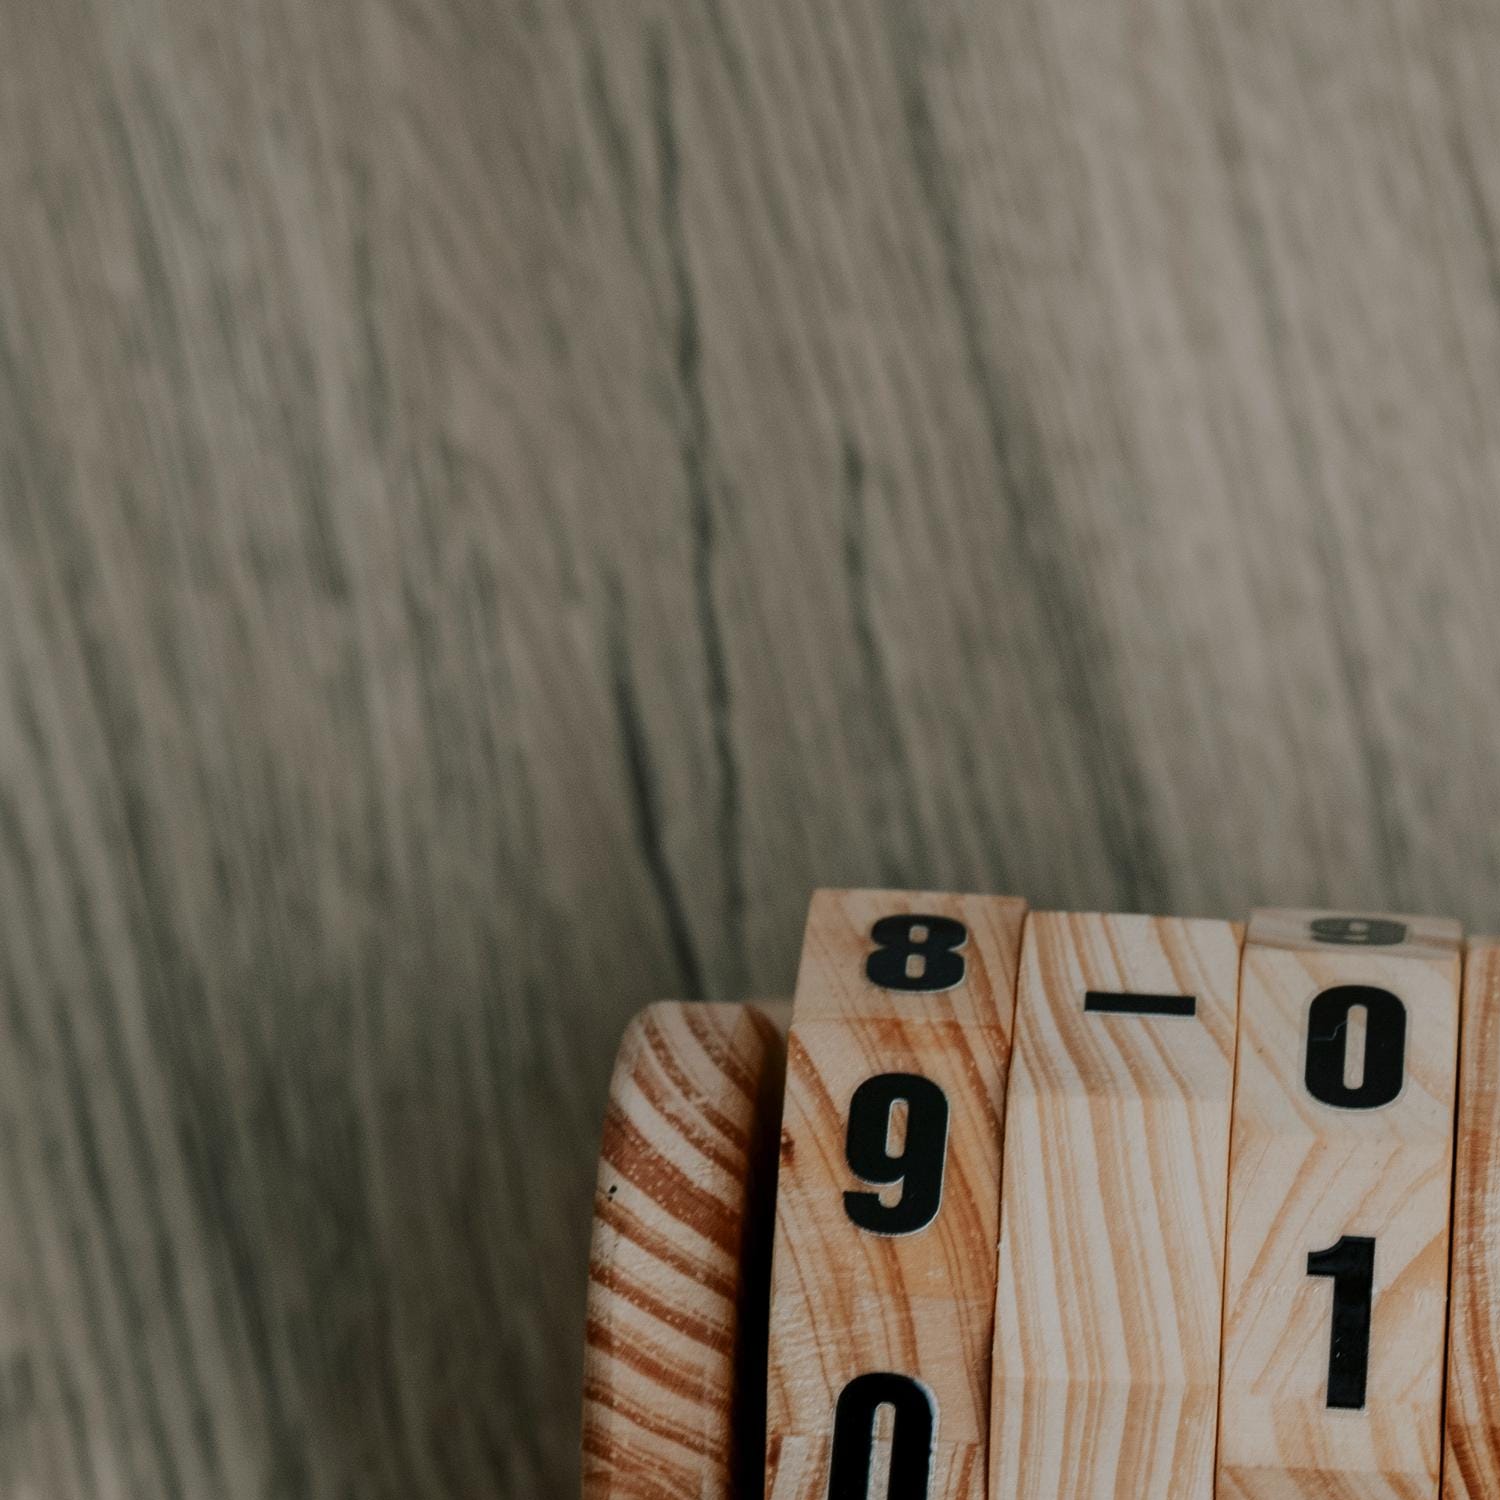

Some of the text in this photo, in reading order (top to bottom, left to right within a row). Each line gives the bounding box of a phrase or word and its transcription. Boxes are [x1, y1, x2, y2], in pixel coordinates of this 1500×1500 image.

[866, 914, 966, 992] 8
[1305, 985, 1406, 1110] 0
[842, 1072, 948, 1235] 9
[1306, 1236, 1376, 1409] 1
